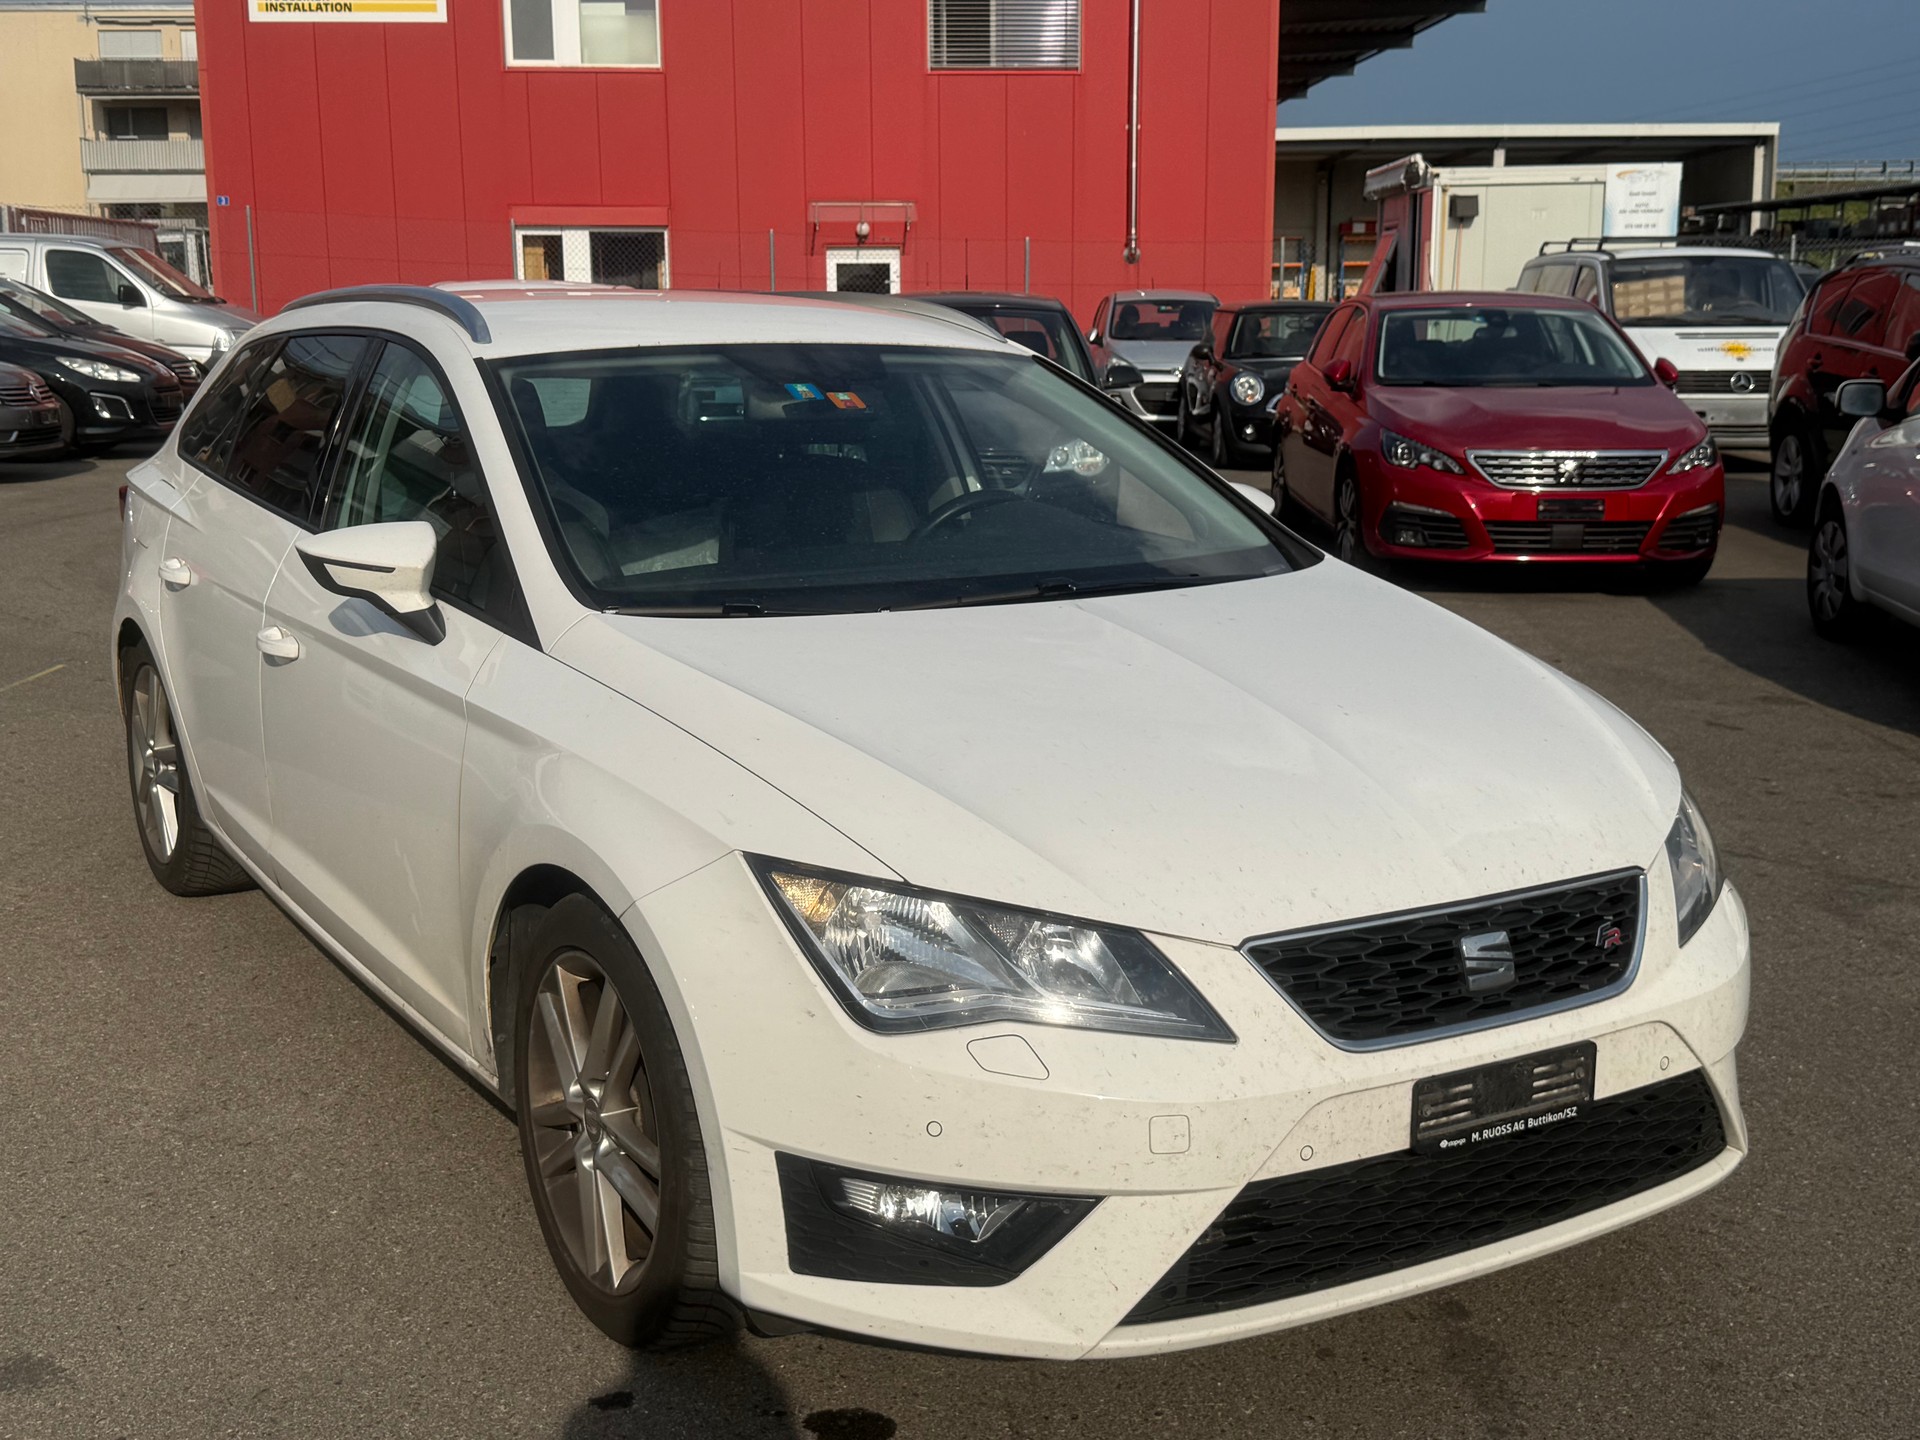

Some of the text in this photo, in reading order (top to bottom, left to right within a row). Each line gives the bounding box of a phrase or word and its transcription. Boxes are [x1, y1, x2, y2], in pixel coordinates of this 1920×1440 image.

[265, 2, 353, 12] INSTALLATION
[1471, 1106, 1578, 1143] M. RUOSS AG Buttikon/SZ
